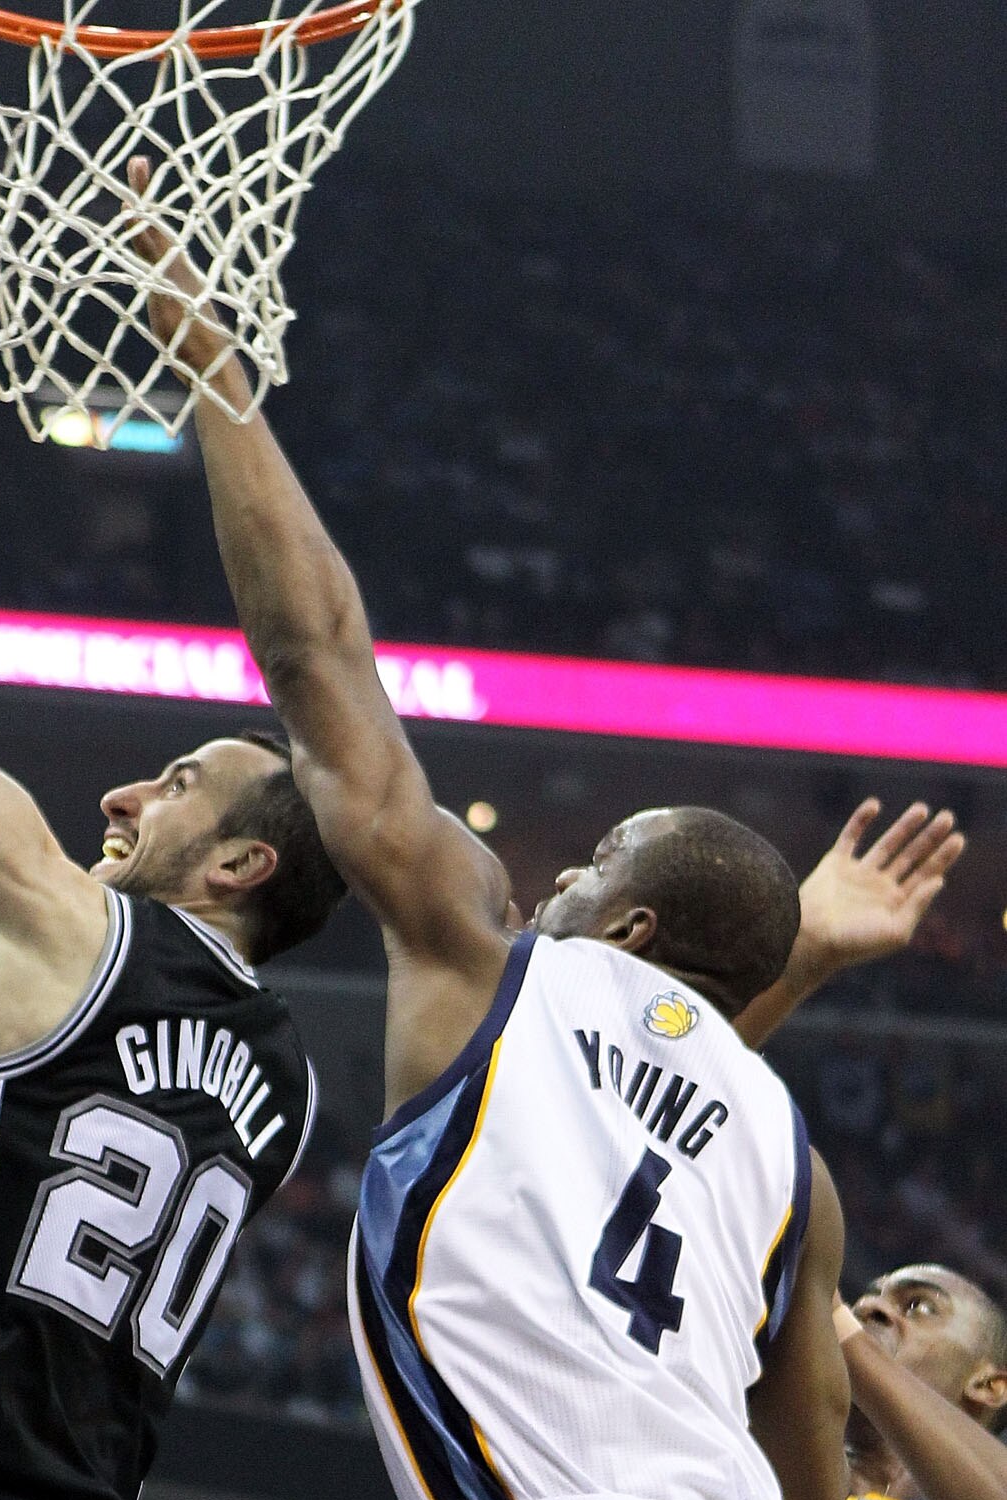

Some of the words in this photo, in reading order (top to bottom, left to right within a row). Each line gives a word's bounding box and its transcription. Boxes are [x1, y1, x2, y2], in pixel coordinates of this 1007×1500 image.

[115, 1018, 286, 1160] GINOBILI
[573, 1028, 729, 1161] YOUNG
[6, 1092, 253, 1380] 20
[586, 1144, 685, 1357] 4
